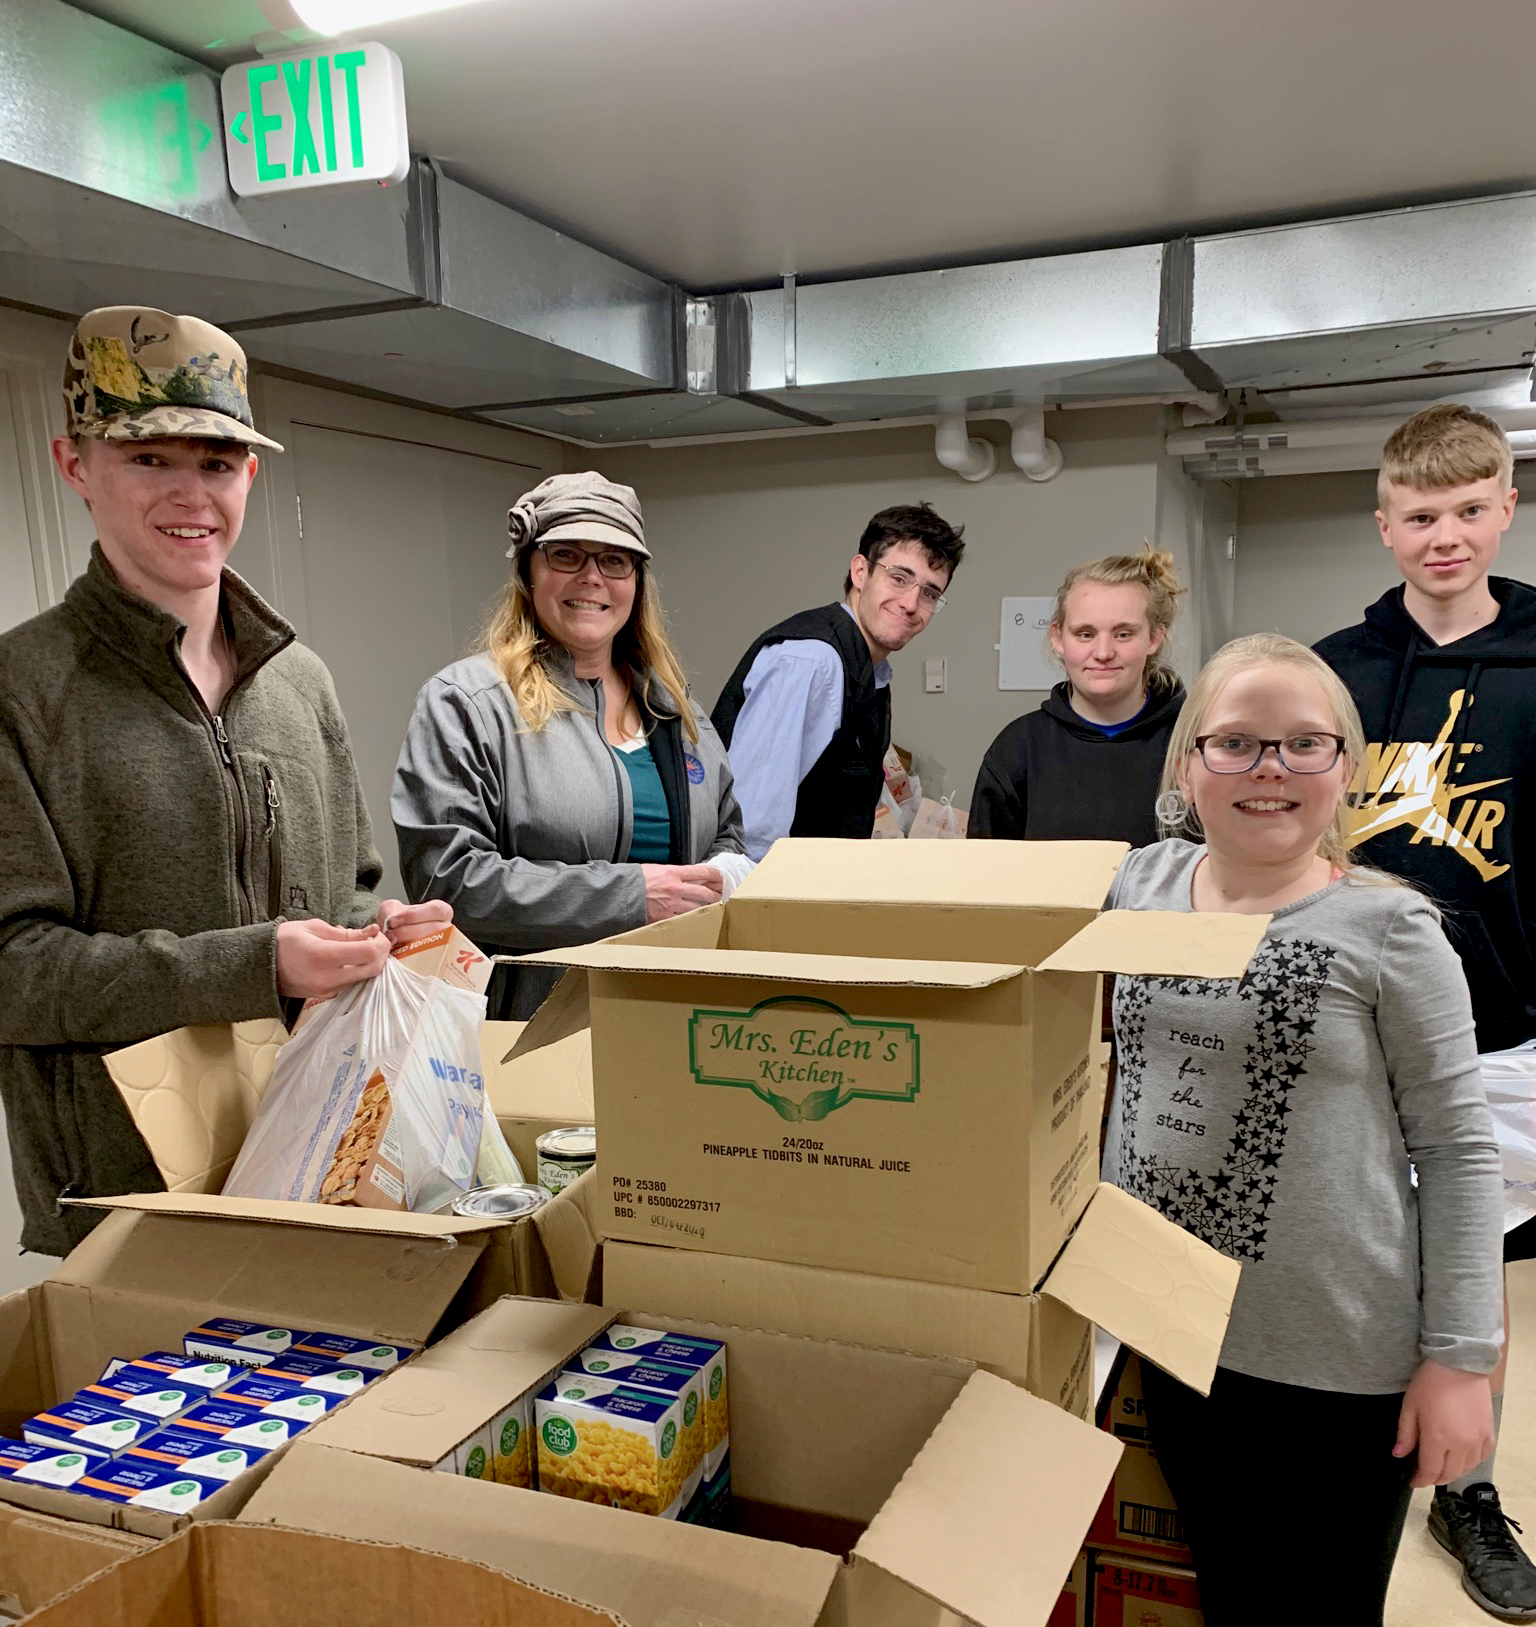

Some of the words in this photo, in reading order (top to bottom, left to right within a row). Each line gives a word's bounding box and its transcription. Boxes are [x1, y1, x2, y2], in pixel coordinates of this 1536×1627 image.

[248, 50, 366, 183] EXIT
[1349, 742, 1476, 794] NIKE
[1408, 799, 1506, 850] AIR
[409, 933, 444, 950] EDITION
[709, 1023, 777, 1053] Mrs.
[789, 1027, 899, 1062] Eden's
[1169, 1029, 1225, 1051] reach
[758, 1059, 844, 1084] Kitchen
[1178, 1056, 1206, 1080] for
[1169, 1086, 1203, 1108] the
[1156, 1112, 1206, 1136] stars
[782, 1136, 824, 1150] 24/20oz
[703, 1144, 758, 1159] PINEAPPLE
[762, 1149, 803, 1163] TIDBITS
[808, 1153, 819, 1164] IN
[824, 1155, 874, 1169] NATURAL
[879, 1160, 911, 1172] JUICE
[613, 1176, 631, 1188] PO#
[636, 1180, 666, 1192] 25380
[614, 1192, 633, 1203] UPC
[638, 1194, 642, 1204] #
[648, 1196, 720, 1212] 850002297317
[614, 1206, 636, 1219] BBD:
[193, 1350, 236, 1364] Nutrition
[611, 1397, 648, 1408] macaroni
[615, 1403, 642, 1412] cheese
[548, 1422, 570, 1438] food
[549, 1434, 570, 1447] club
